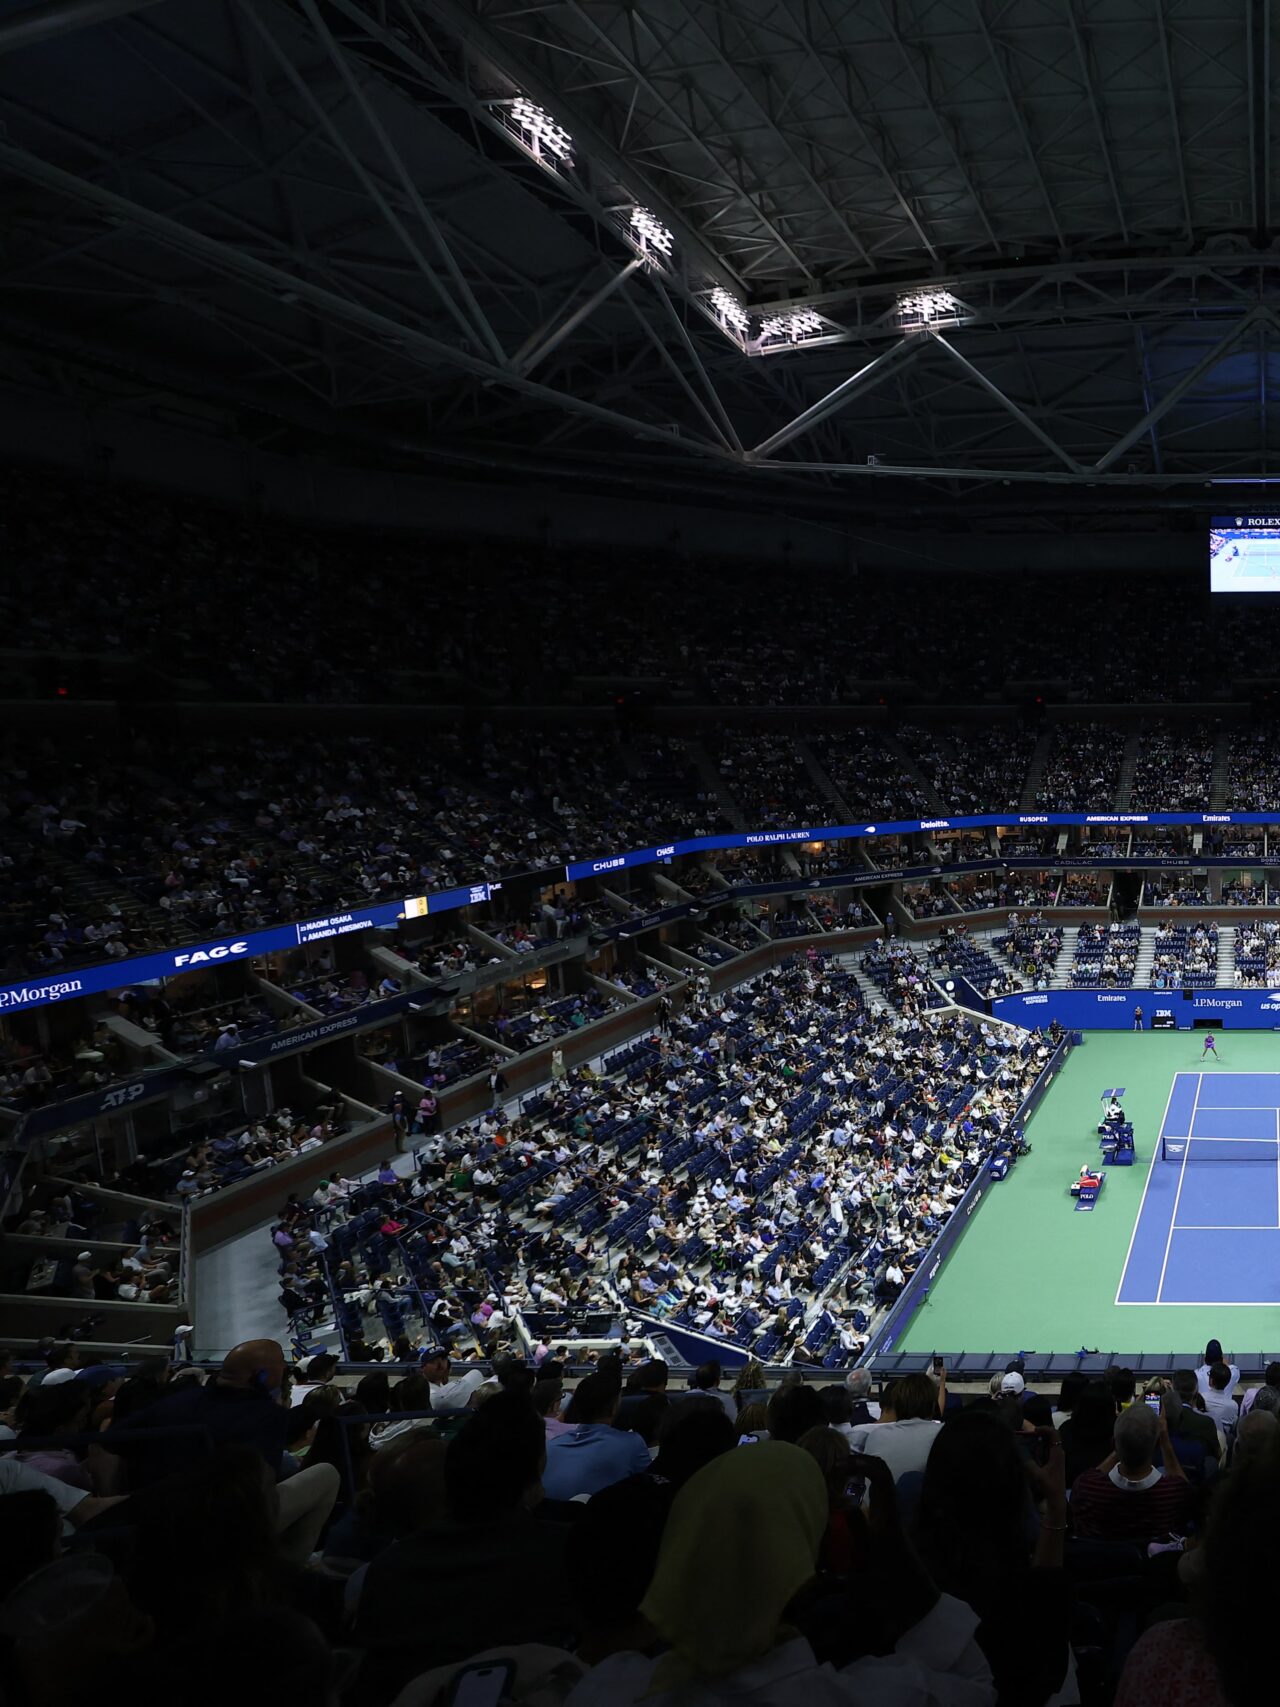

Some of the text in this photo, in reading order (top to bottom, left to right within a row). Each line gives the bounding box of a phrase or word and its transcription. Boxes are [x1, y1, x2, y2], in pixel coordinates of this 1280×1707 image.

[1248, 518, 1280, 526] ROLEX
[1202, 814, 1231, 822] Emirates
[746, 831, 811, 844] POLO RALPH LAUREN
[656, 846, 674, 856] CHASE
[593, 858, 625, 872] CHUBB
[470, 891, 487, 904] IBM
[306, 919, 329, 930] NAOMI
[330, 914, 353, 925] OSAKA
[308, 928, 337, 941] AMANDA
[174, 941, 249, 967] FAGE
[1097, 994, 1127, 1002] Emirates
[1193, 998, 1243, 1009] J.P.Morgan
[1156, 1009, 1171, 1017] IBM
[270, 1016, 359, 1052] AMERICAN EXPRESS
[99, 1083, 145, 1111] ATP
